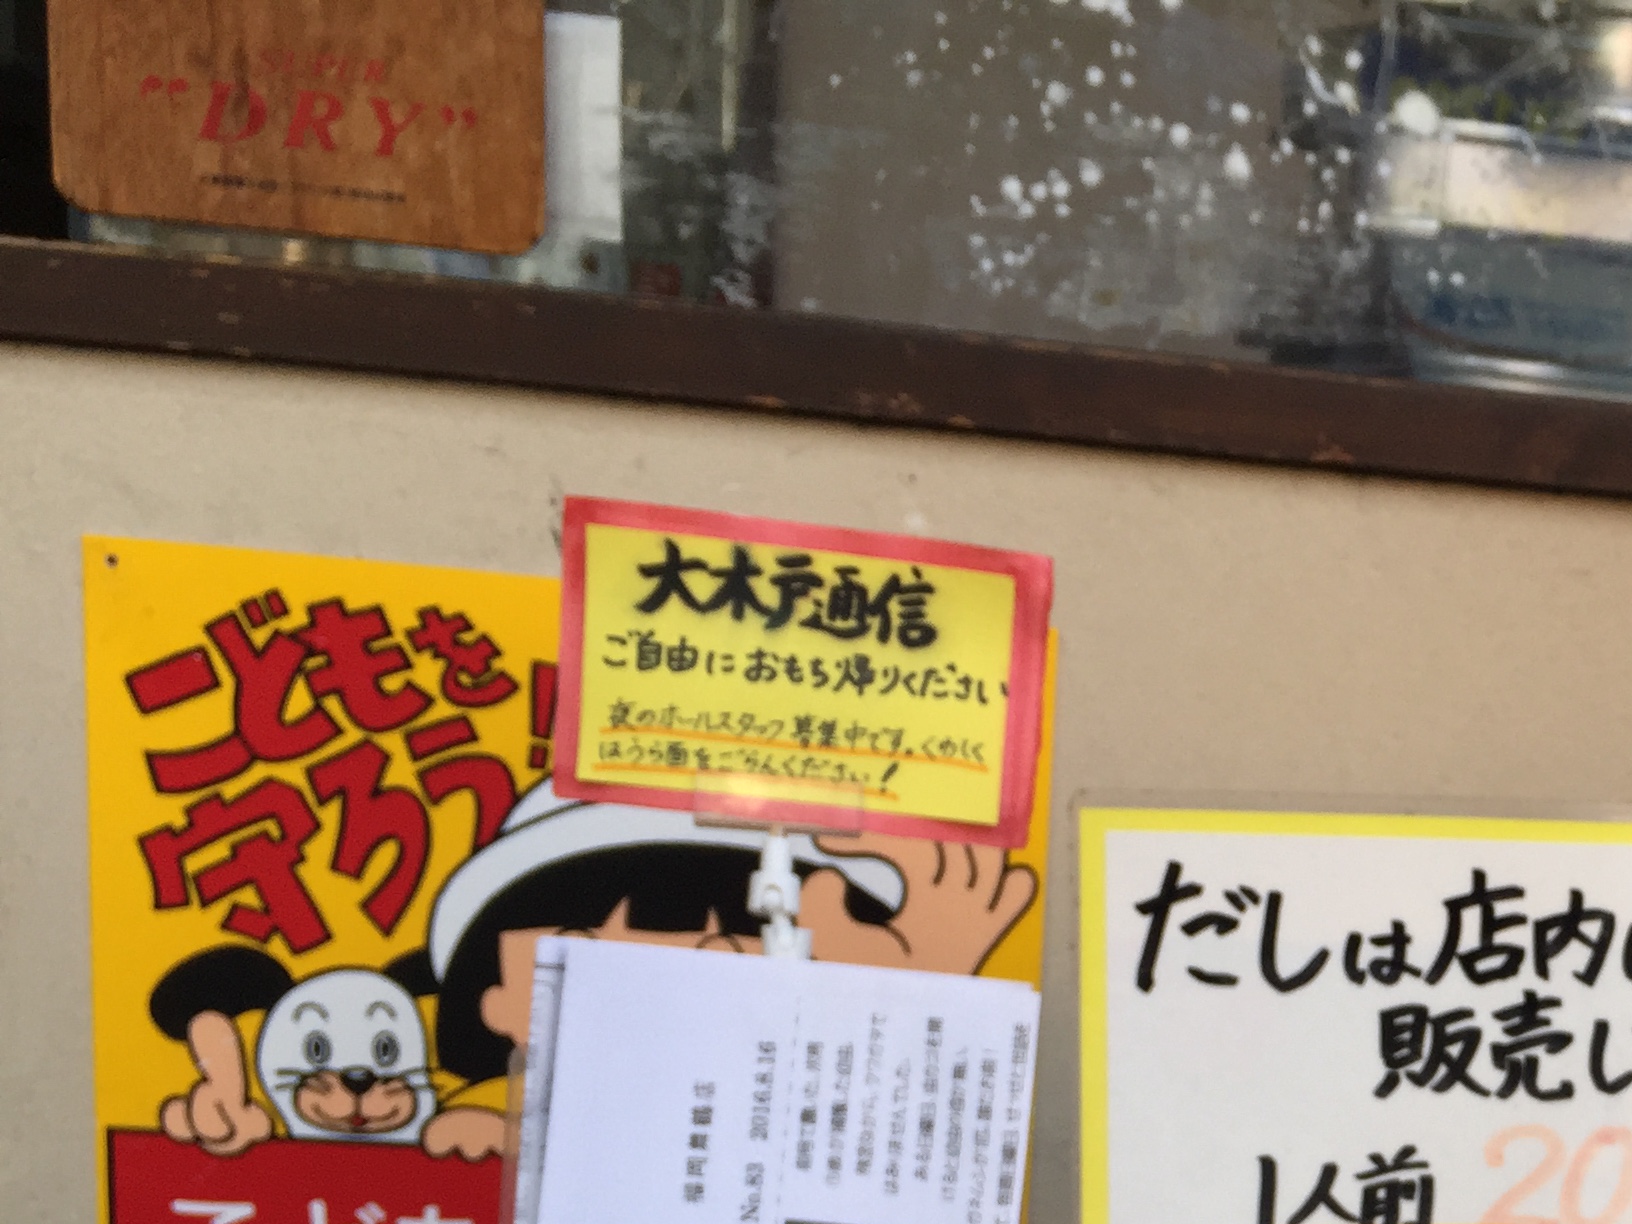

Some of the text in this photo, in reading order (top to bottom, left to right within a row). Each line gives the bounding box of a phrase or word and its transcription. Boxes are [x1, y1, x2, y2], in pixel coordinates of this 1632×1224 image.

[636, 538, 938, 648] 大木戸通信
[124, 588, 520, 793] こどもを
